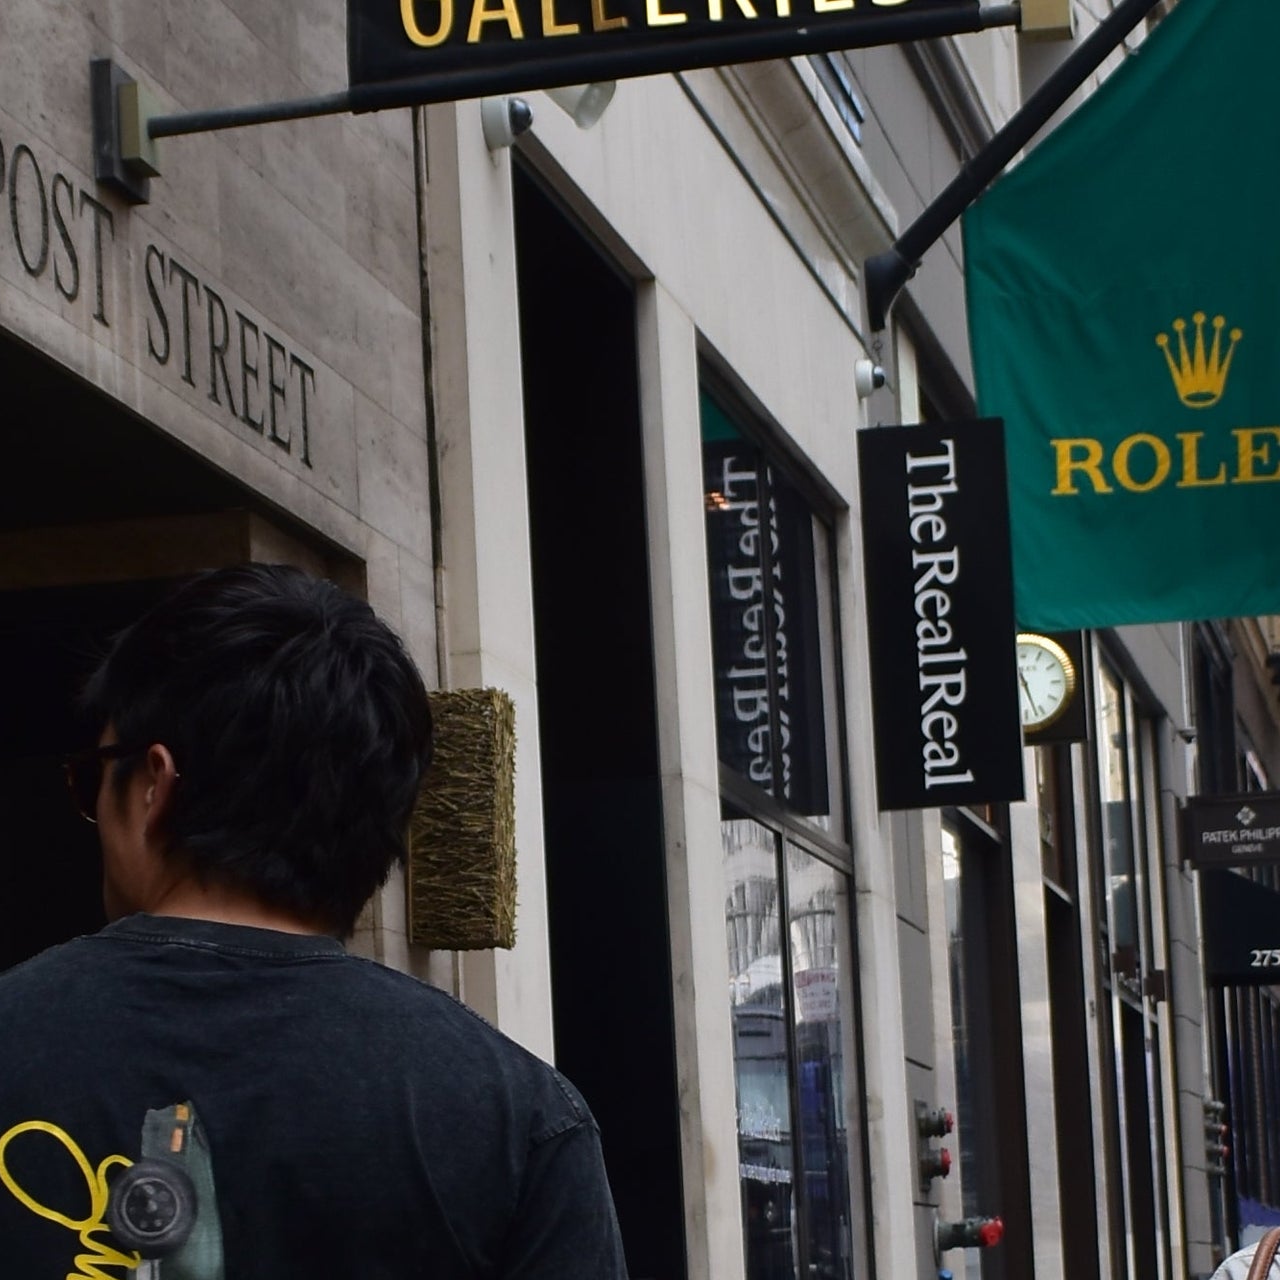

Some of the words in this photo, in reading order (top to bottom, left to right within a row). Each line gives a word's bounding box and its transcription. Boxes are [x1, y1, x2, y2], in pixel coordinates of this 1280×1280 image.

[145, 244, 316, 470] STREET
[906, 438, 976, 791] TheRealReal
[1202, 830, 1238, 843] PATEK
